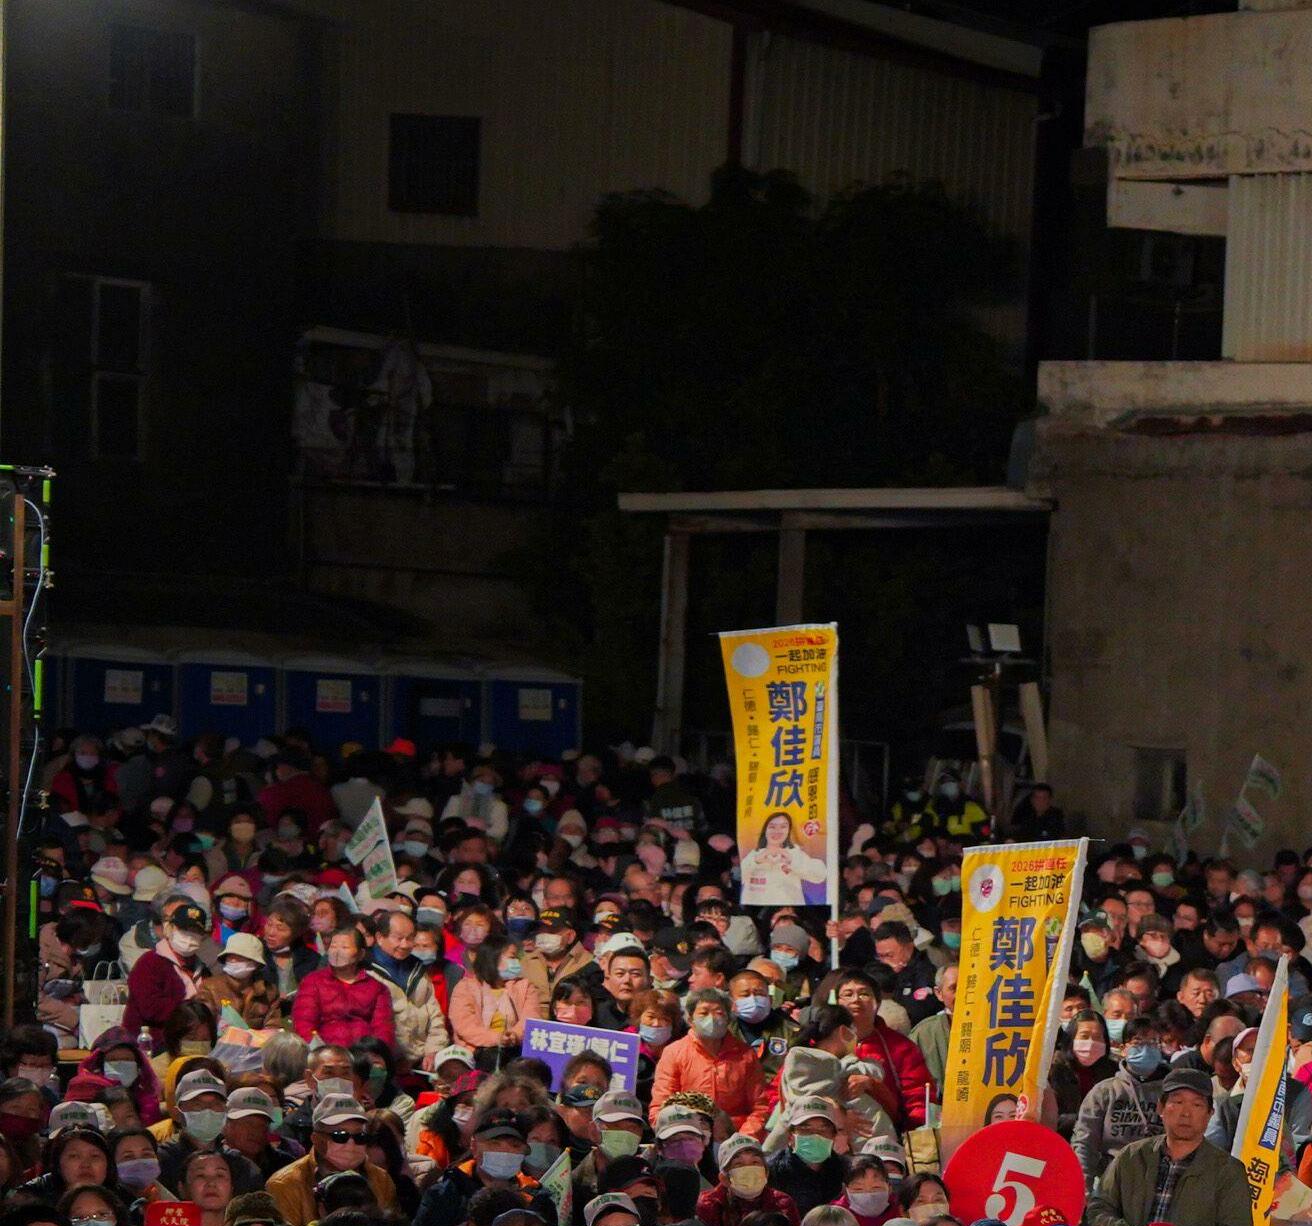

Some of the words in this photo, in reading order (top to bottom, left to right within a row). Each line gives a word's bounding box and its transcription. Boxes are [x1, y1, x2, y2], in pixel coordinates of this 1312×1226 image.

[775, 648, 827, 662] 一起加油
[777, 662, 827, 675] FIGHTING
[764, 681, 808, 807] 鄭佳欣
[1010, 893, 1065, 907] FIGHTING
[982, 916, 1037, 1088] 鄭佳欣
